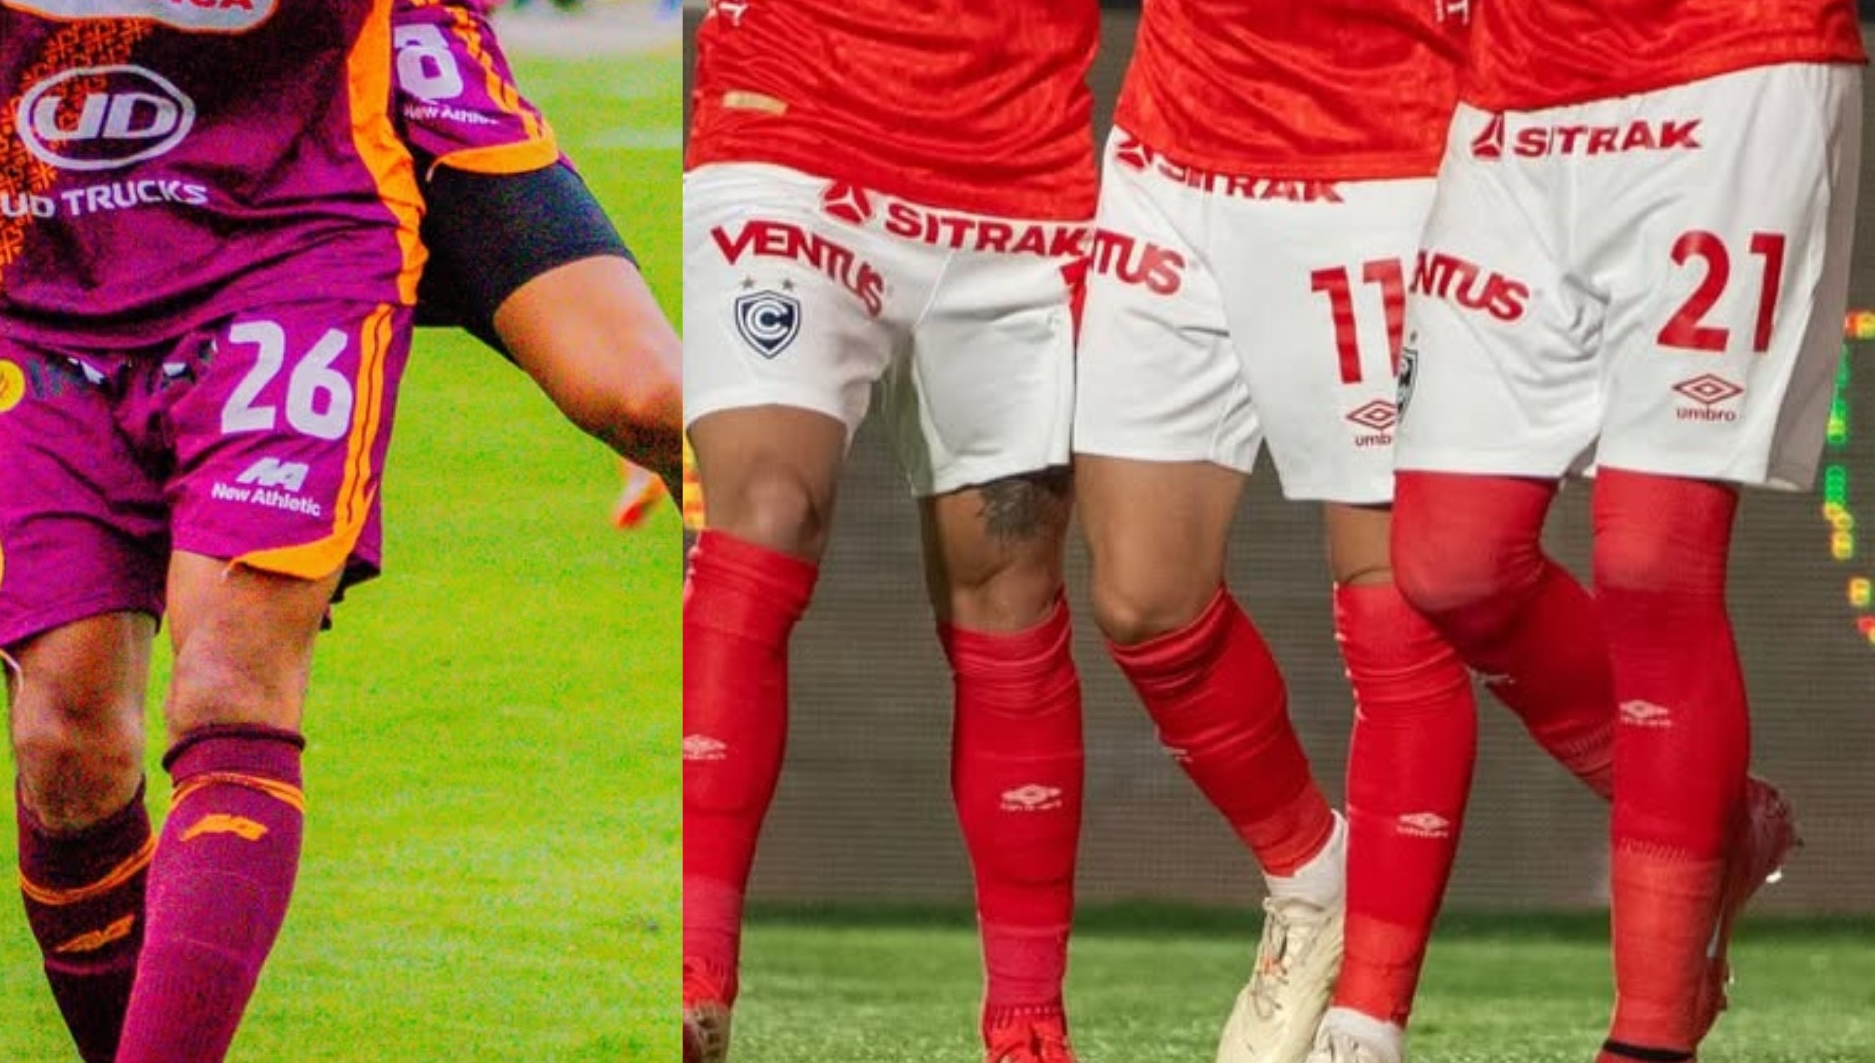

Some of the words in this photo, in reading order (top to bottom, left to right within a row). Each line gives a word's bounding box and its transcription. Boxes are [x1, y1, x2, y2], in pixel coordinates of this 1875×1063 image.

[33, 92, 178, 140] UD
[1512, 118, 1704, 158] SITRAK
[0, 191, 56, 220] UD
[61, 178, 209, 217] TRUCKS
[884, 202, 1093, 259] SITRAK
[711, 220, 885, 319] VENTUS
[1090, 226, 1187, 296] TUS
[1411, 249, 1529, 322] NTUS
[1656, 230, 1787, 353] 21
[1310, 257, 1404, 385] 11
[220, 319, 354, 440] 26
[1354, 433, 1393, 448] umb
[1676, 404, 1738, 423] umbro
[212, 481, 250, 502] New
[251, 488, 322, 517] Athletic
